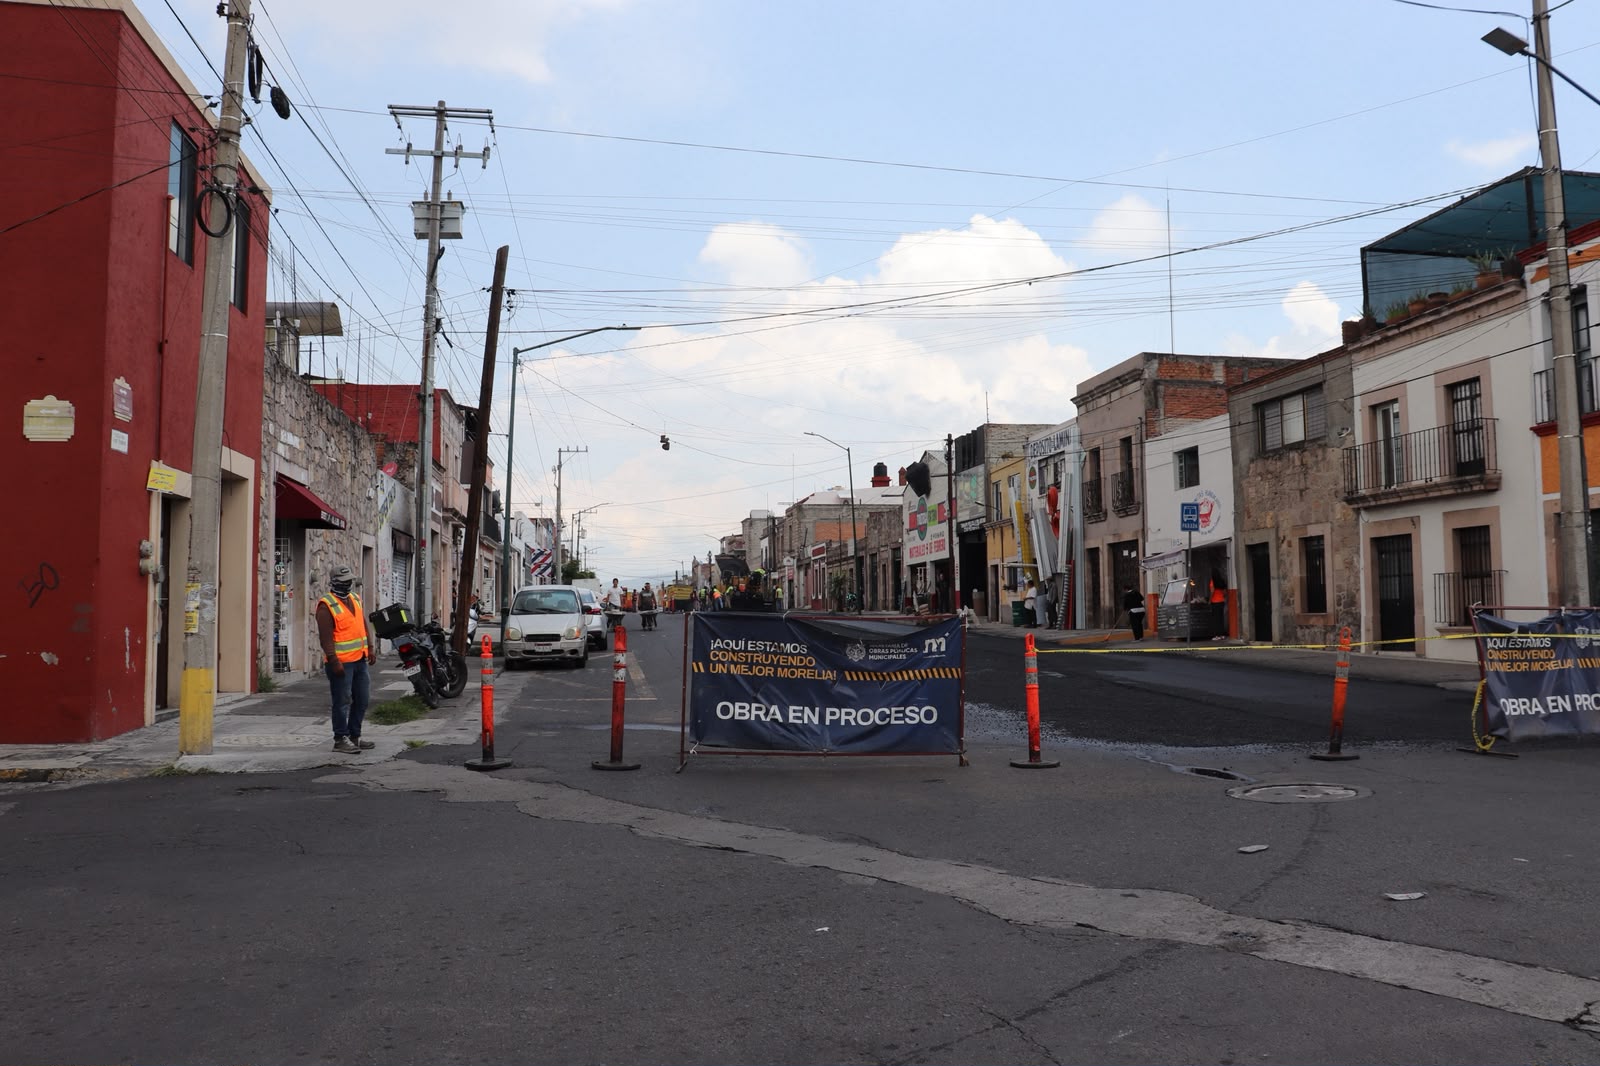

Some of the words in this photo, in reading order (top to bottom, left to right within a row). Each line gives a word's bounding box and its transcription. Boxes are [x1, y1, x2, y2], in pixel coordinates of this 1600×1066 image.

[710, 638, 746, 652] ¡AQUÍ
[748, 640, 808, 654] ESTAMOS
[1508, 638, 1551, 648] ESTAMOS
[710, 650, 816, 667] CONSTRUYENDO
[710, 664, 728, 674] UN
[730, 664, 774, 676] MEJOR
[777, 668, 836, 680] MORELIA!
[1500, 698, 1545, 715] OBRA
[1546, 695, 1572, 713] EN
[716, 701, 783, 722] OBRA
[788, 706, 820, 725] EN
[826, 706, 938, 726] PROCESO
